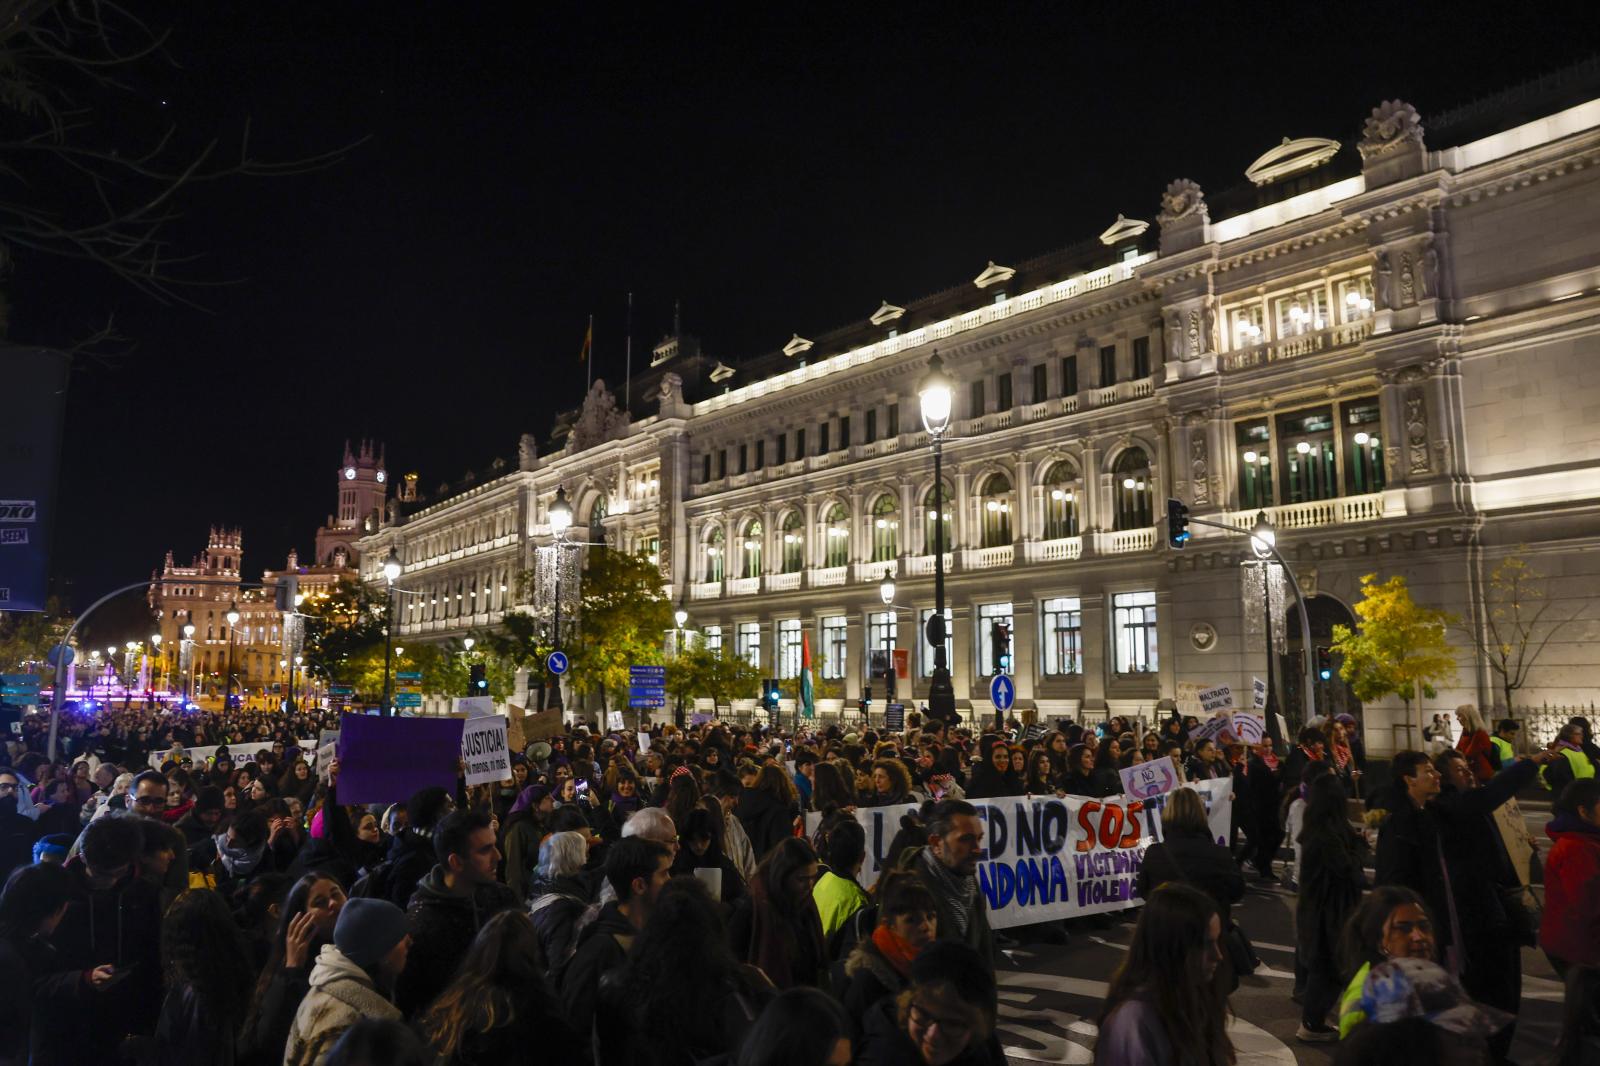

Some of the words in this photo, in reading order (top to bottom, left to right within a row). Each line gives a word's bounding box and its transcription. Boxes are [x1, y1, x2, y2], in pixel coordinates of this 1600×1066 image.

[1199, 687, 1230, 702] MALTRATO
[1142, 770, 1154, 782] NO
[1016, 800, 1068, 857] NO
[1076, 800, 1144, 852] SOS
[978, 855, 1069, 911] NDONA
[1077, 878, 1137, 907] VIOLENC
